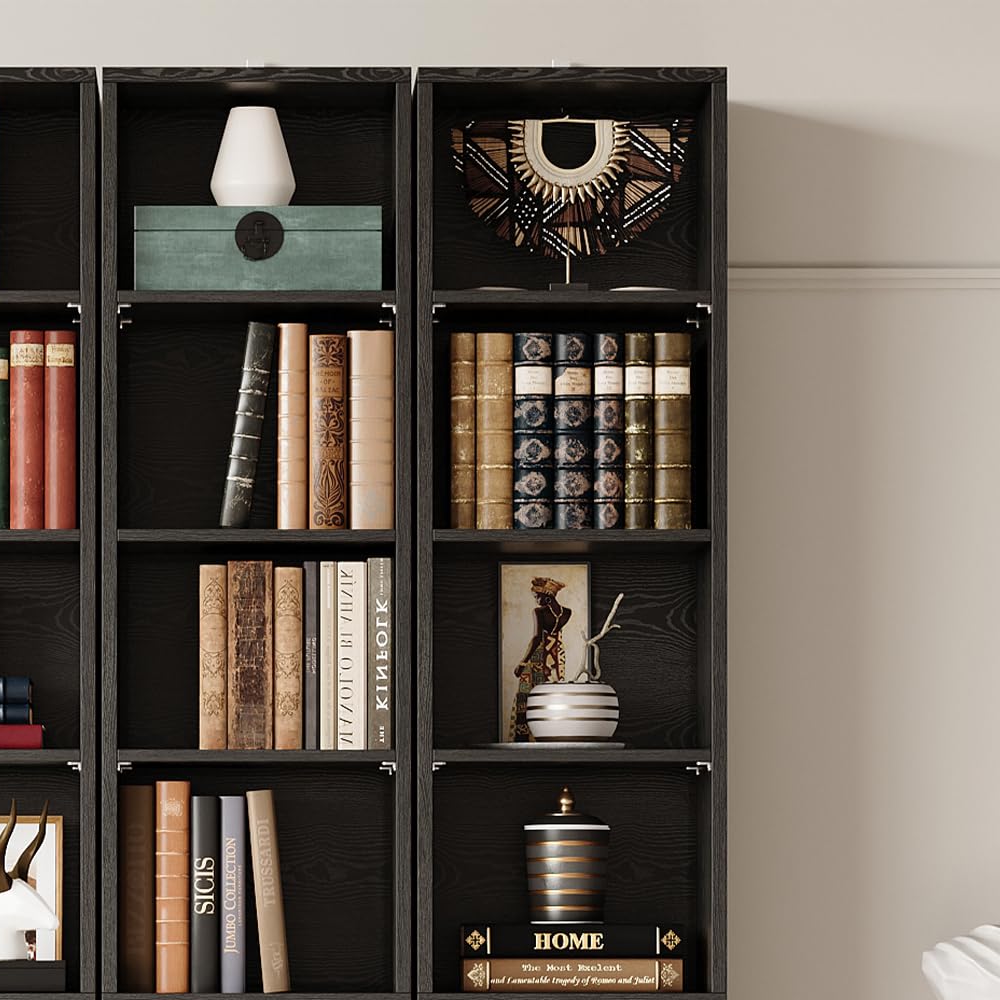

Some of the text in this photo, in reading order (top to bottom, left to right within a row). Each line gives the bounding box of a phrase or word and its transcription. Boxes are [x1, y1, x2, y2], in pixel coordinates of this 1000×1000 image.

[256, 817, 276, 908] TRUSSARDI
[194, 856, 215, 915] SICIS
[223, 837, 239, 953] JUMBO COLLECTION
[534, 932, 604, 951] HOME
[490, 976, 506, 984] and
[581, 976, 591, 986] of
[591, 976, 616, 985] Romeo
[617, 976, 633, 984] and
[633, 976, 655, 985] Juliet
[522, 964, 541, 972] The
[546, 964, 572, 972] Most
